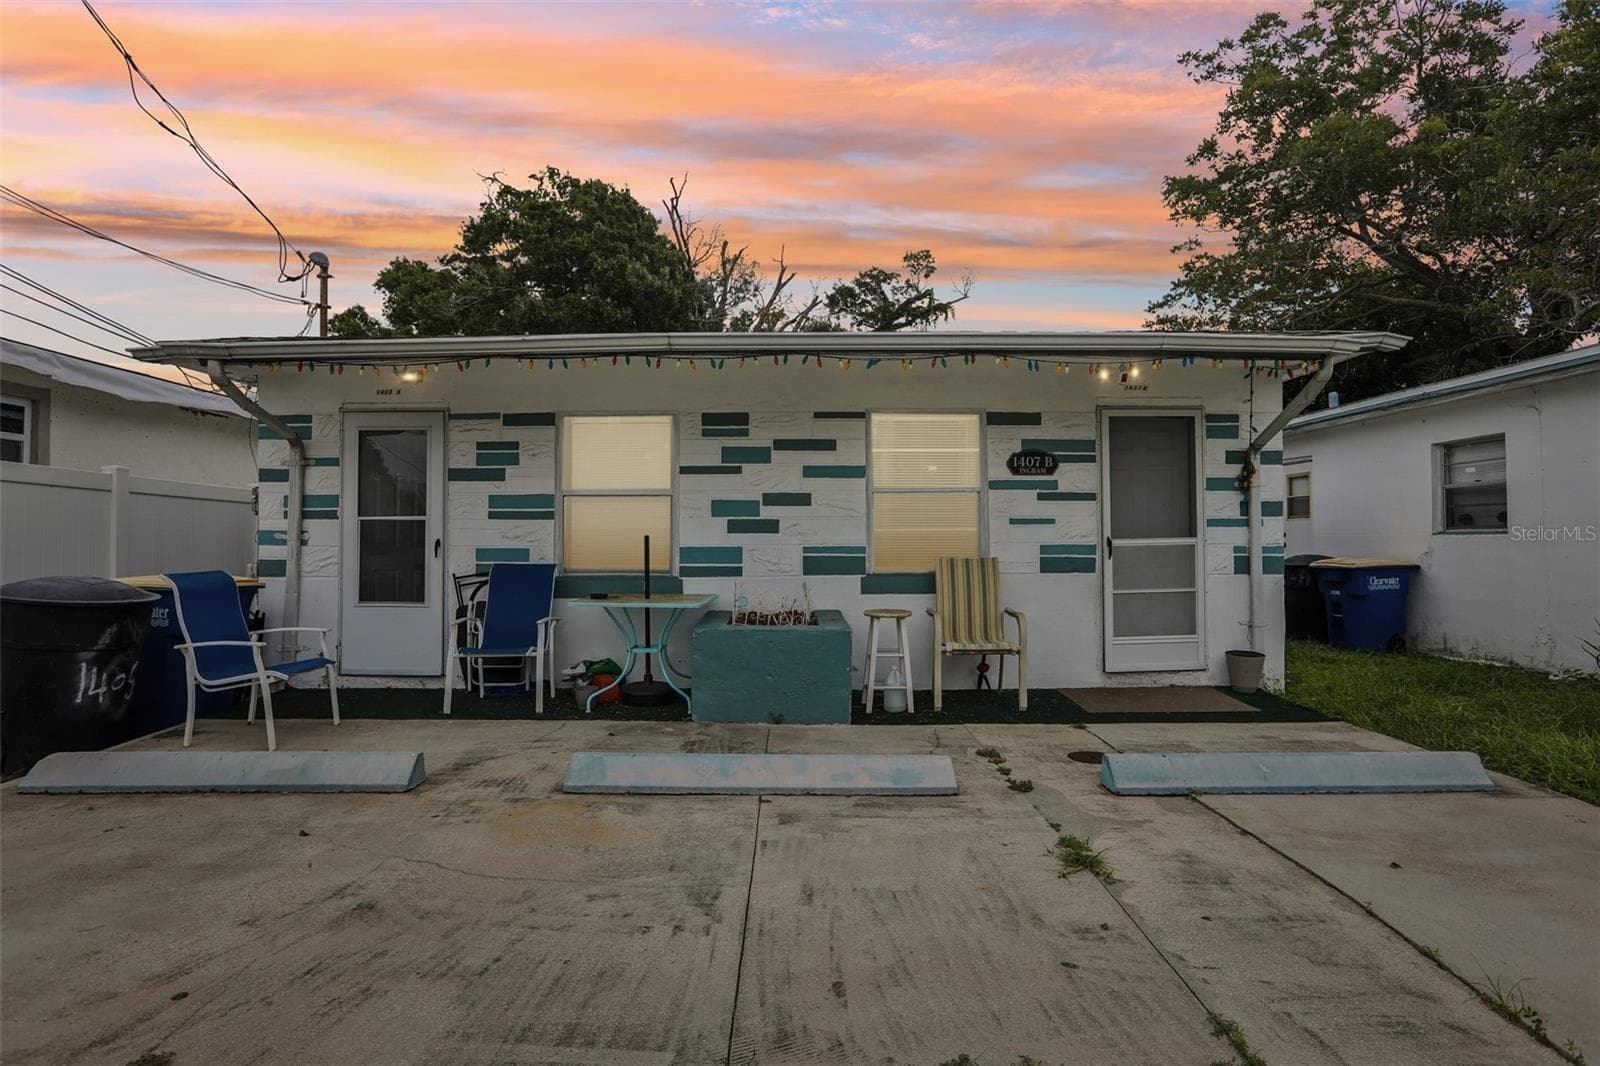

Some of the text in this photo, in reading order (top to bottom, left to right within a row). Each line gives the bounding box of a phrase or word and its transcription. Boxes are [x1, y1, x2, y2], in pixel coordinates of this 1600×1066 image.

[1013, 456, 1053, 468] 1407 B
[1369, 575, 1400, 586] Clearwater
[151, 606, 169, 619] ater
